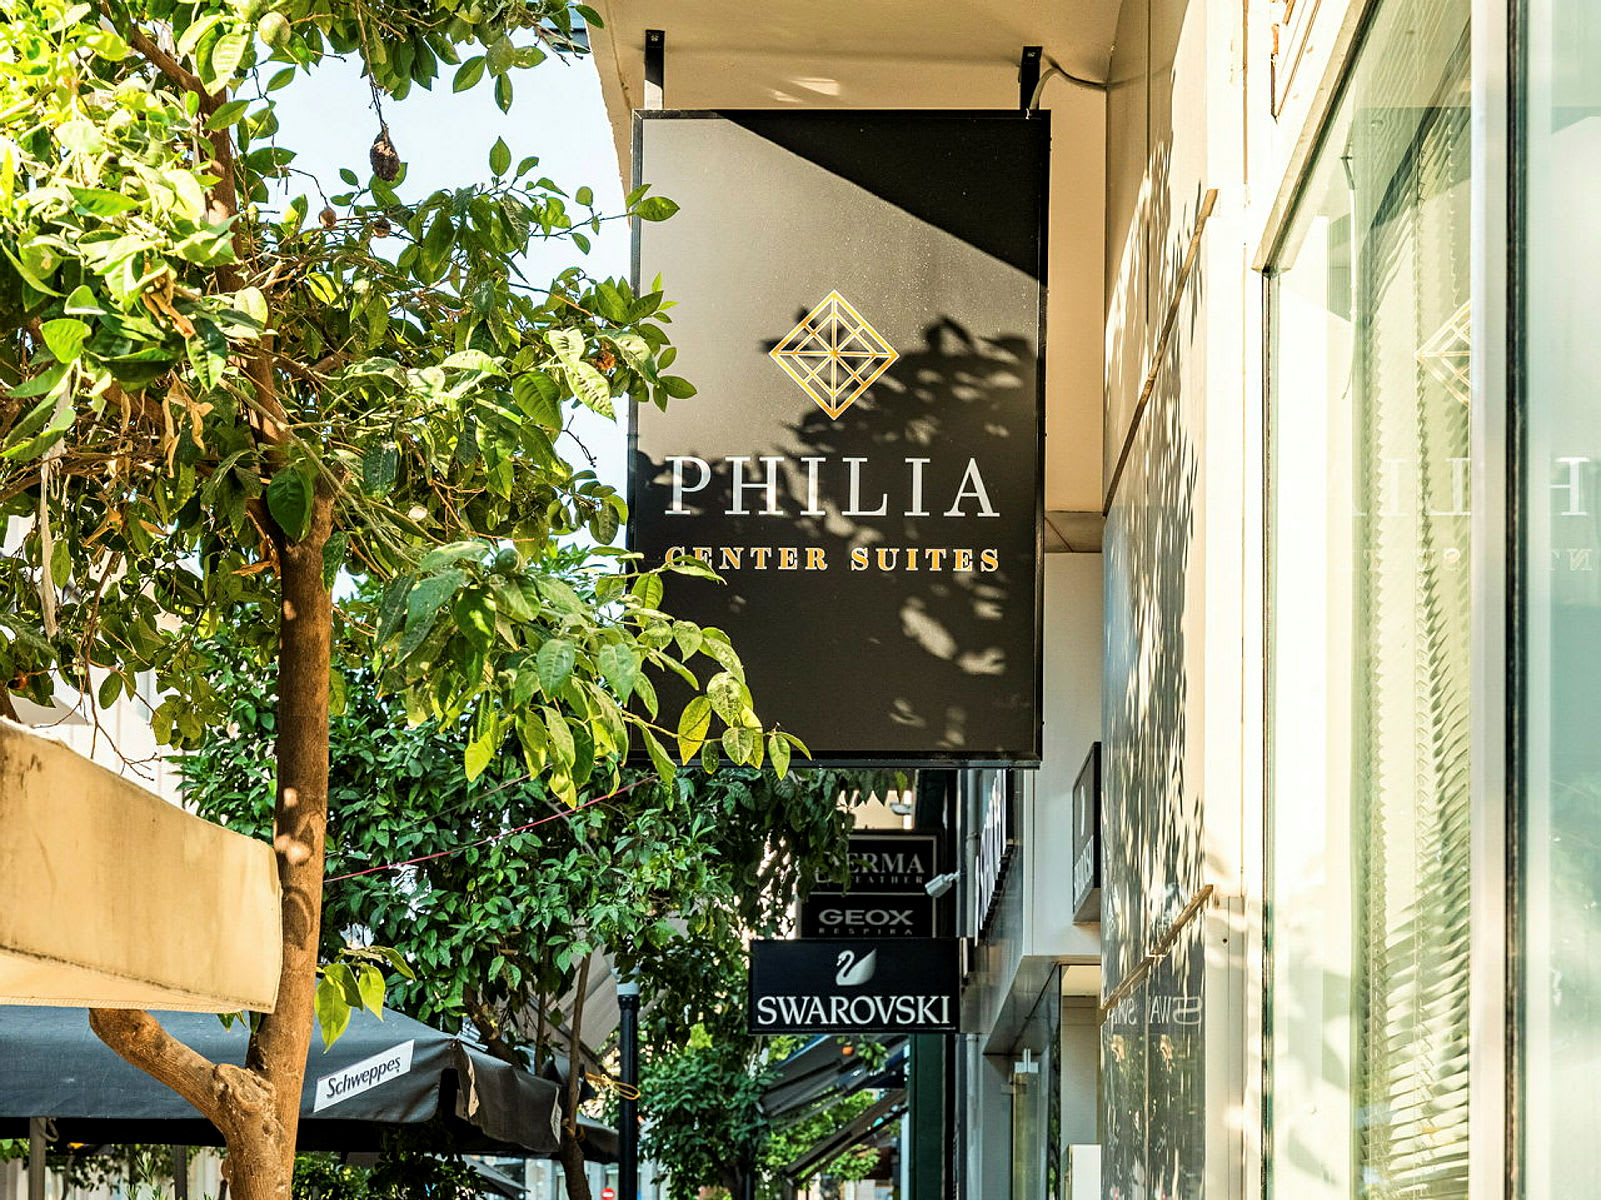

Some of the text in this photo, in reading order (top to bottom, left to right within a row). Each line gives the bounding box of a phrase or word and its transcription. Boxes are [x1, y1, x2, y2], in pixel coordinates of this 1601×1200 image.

[664, 455, 1001, 518] PHILIA
[850, 546, 1000, 572] SUITES
[818, 908, 914, 926] GEOX
[818, 927, 913, 935] RESPIRA
[757, 995, 951, 1026] SWAROVSKI
[326, 1056, 401, 1098] Schweppes
